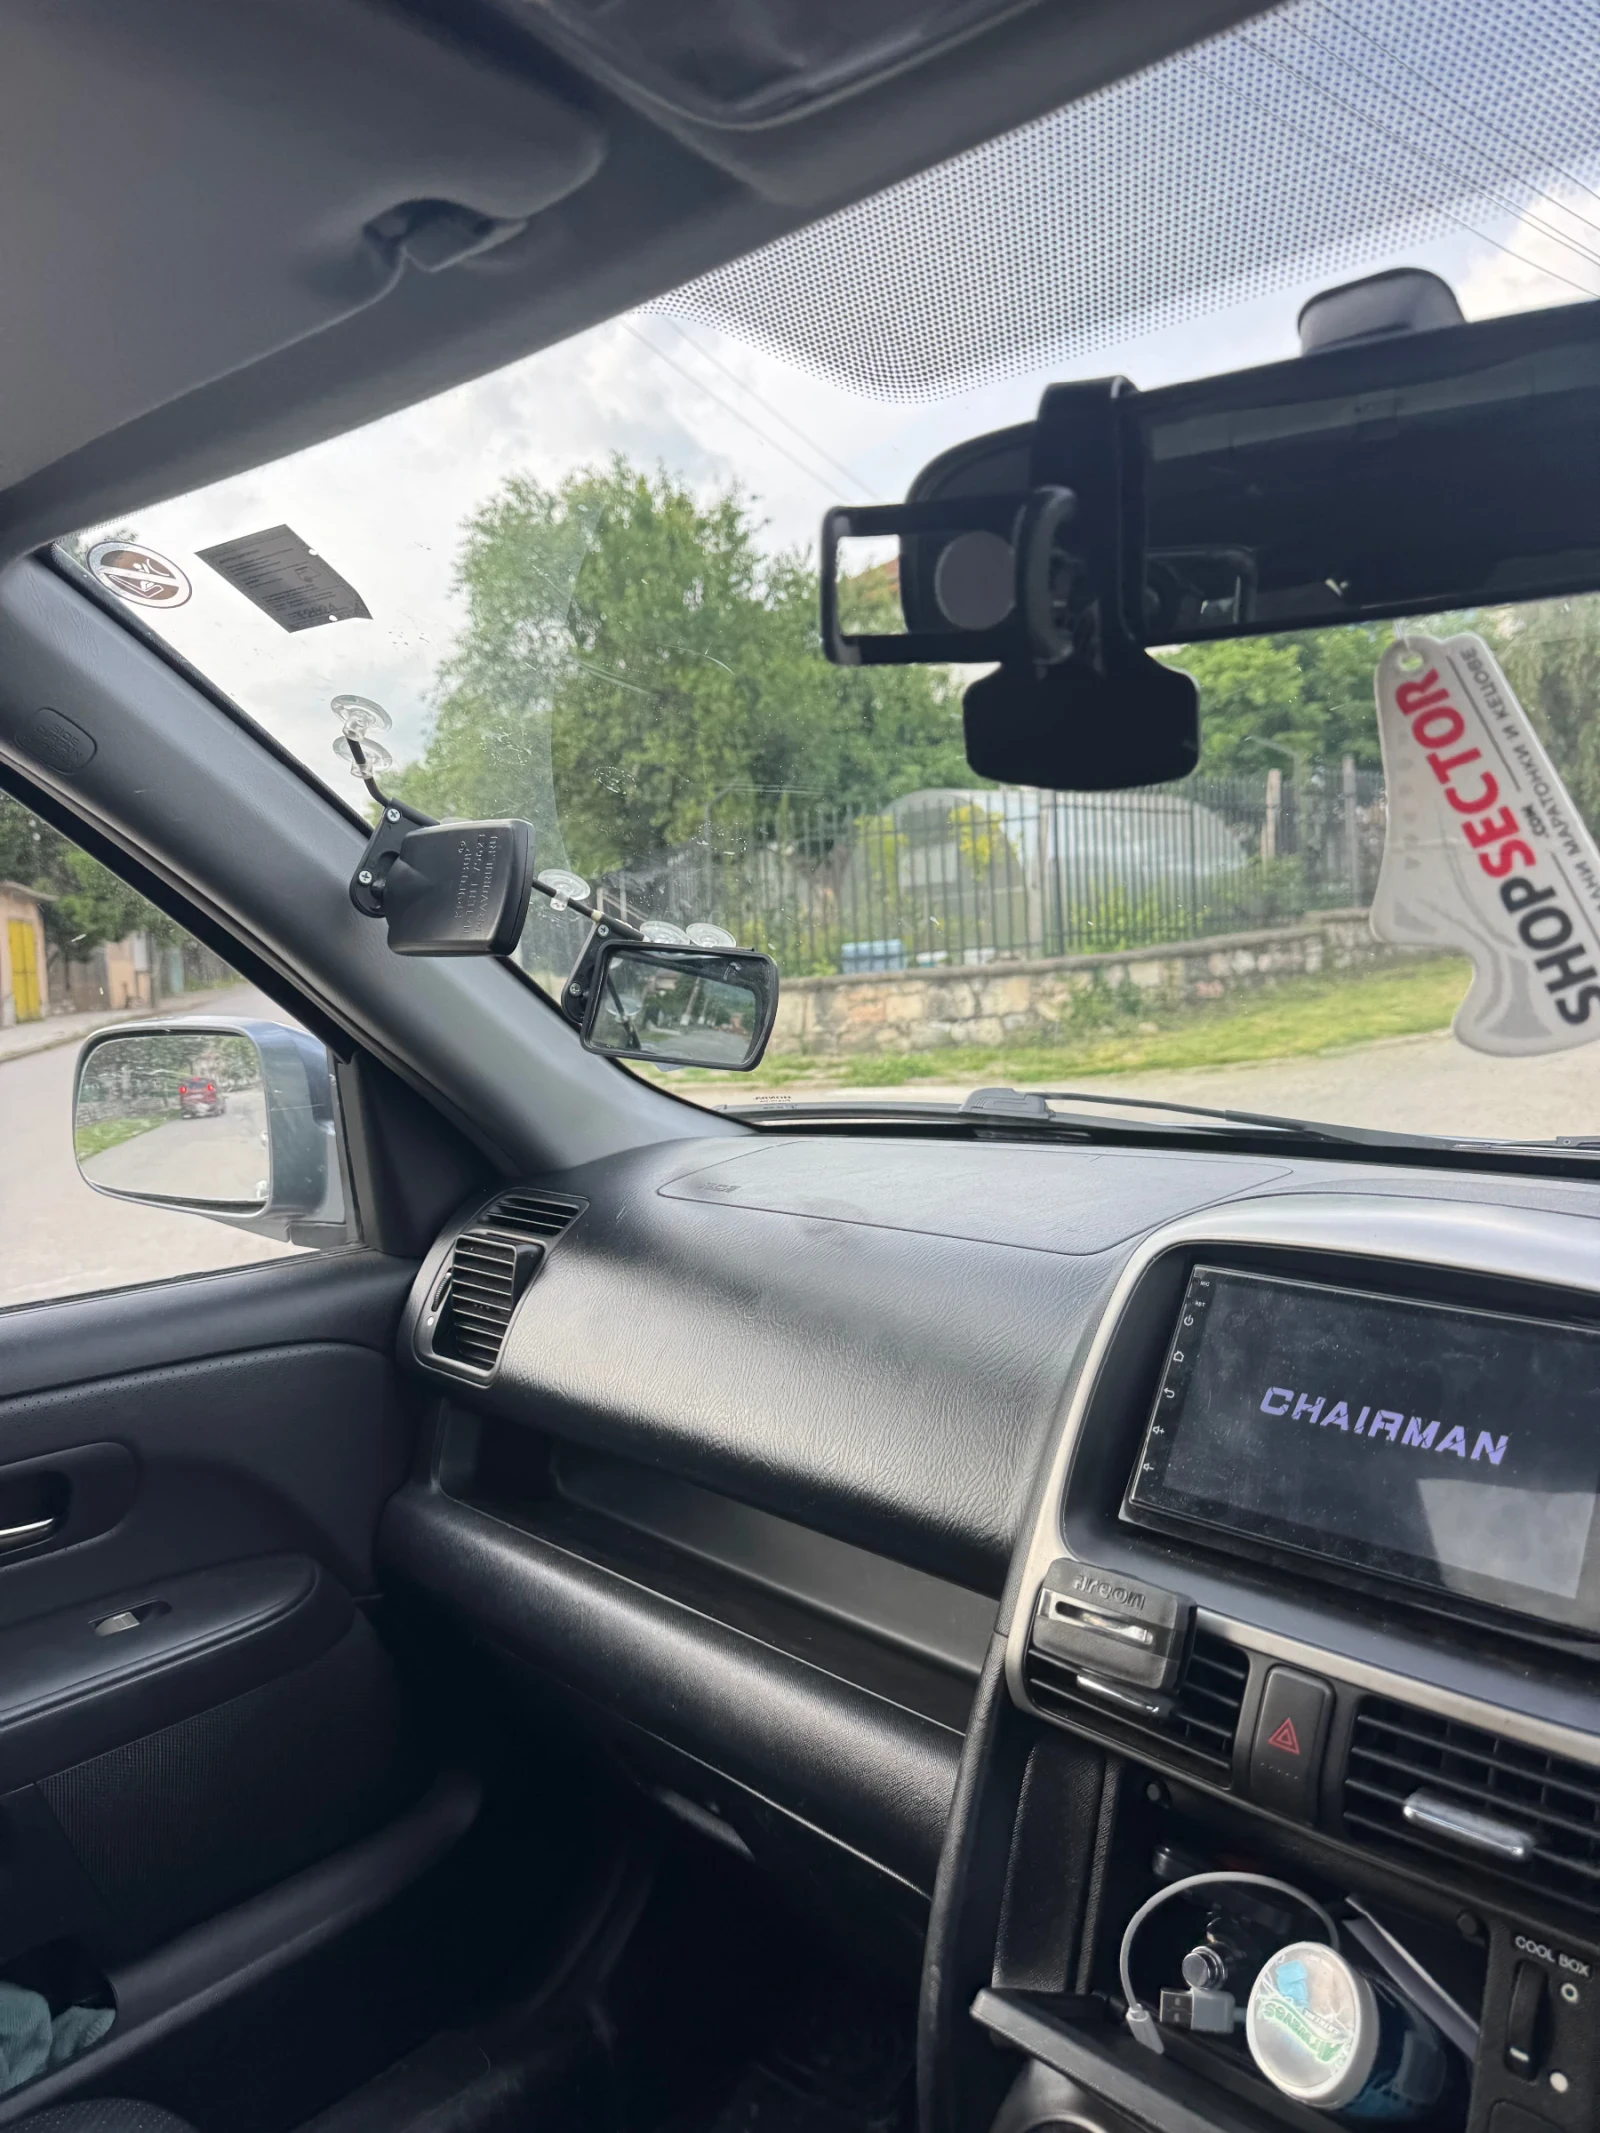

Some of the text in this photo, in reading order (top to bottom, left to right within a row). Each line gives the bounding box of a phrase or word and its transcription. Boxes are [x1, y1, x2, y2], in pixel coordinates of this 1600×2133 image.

[1460, 647, 1580, 856] МАРАТОНКИ И КЕЦОВЕ
[1395, 668, 1600, 1026] SHOPSECTOR
[1260, 1386, 1510, 1465] CHAIRMAN
[1072, 1575, 1146, 1611] areon
[1515, 1935, 1590, 1977] COOL BOX
[1264, 2002, 1343, 2062] Airwaves
